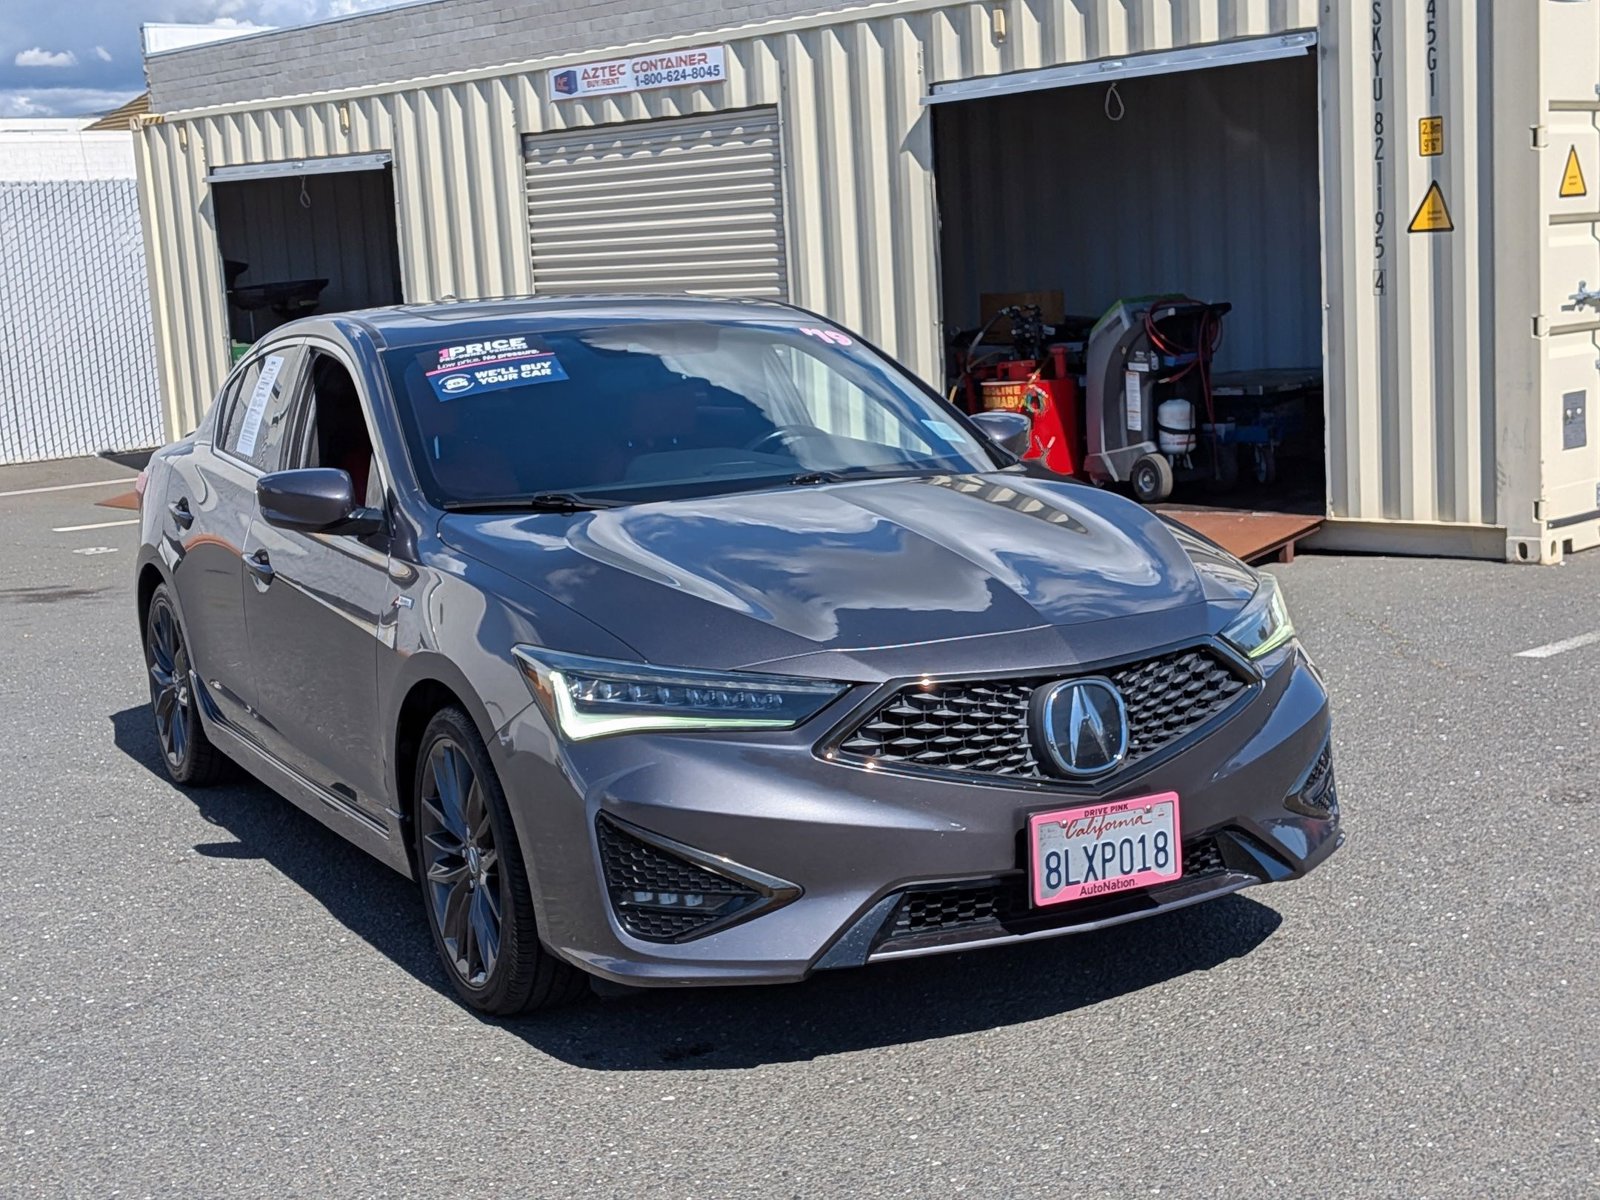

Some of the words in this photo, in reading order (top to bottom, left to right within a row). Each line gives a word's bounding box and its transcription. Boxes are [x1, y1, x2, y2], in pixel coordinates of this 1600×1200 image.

[1372, 2, 1383, 101] SKYU
[581, 63, 627, 81] AZTEC
[632, 52, 708, 74] CONTAINER
[634, 64, 720, 87] 1-800-624-8045
[1373, 112, 1385, 260] 821195
[1374, 271, 1385, 295] 4
[437, 362, 455, 370] Low
[497, 349, 540, 360] pressure.
[474, 366, 519, 379] WE'LL
[520, 361, 552, 371] BUY
[478, 373, 519, 385] YOUR
[520, 368, 552, 378] CAR
[1084, 807, 1109, 818] DRIVE
[1110, 803, 1129, 813] PINK
[1065, 813, 1152, 840] California
[1045, 830, 1169, 890] 8LXP018
[1079, 878, 1136, 897] AutoNation
